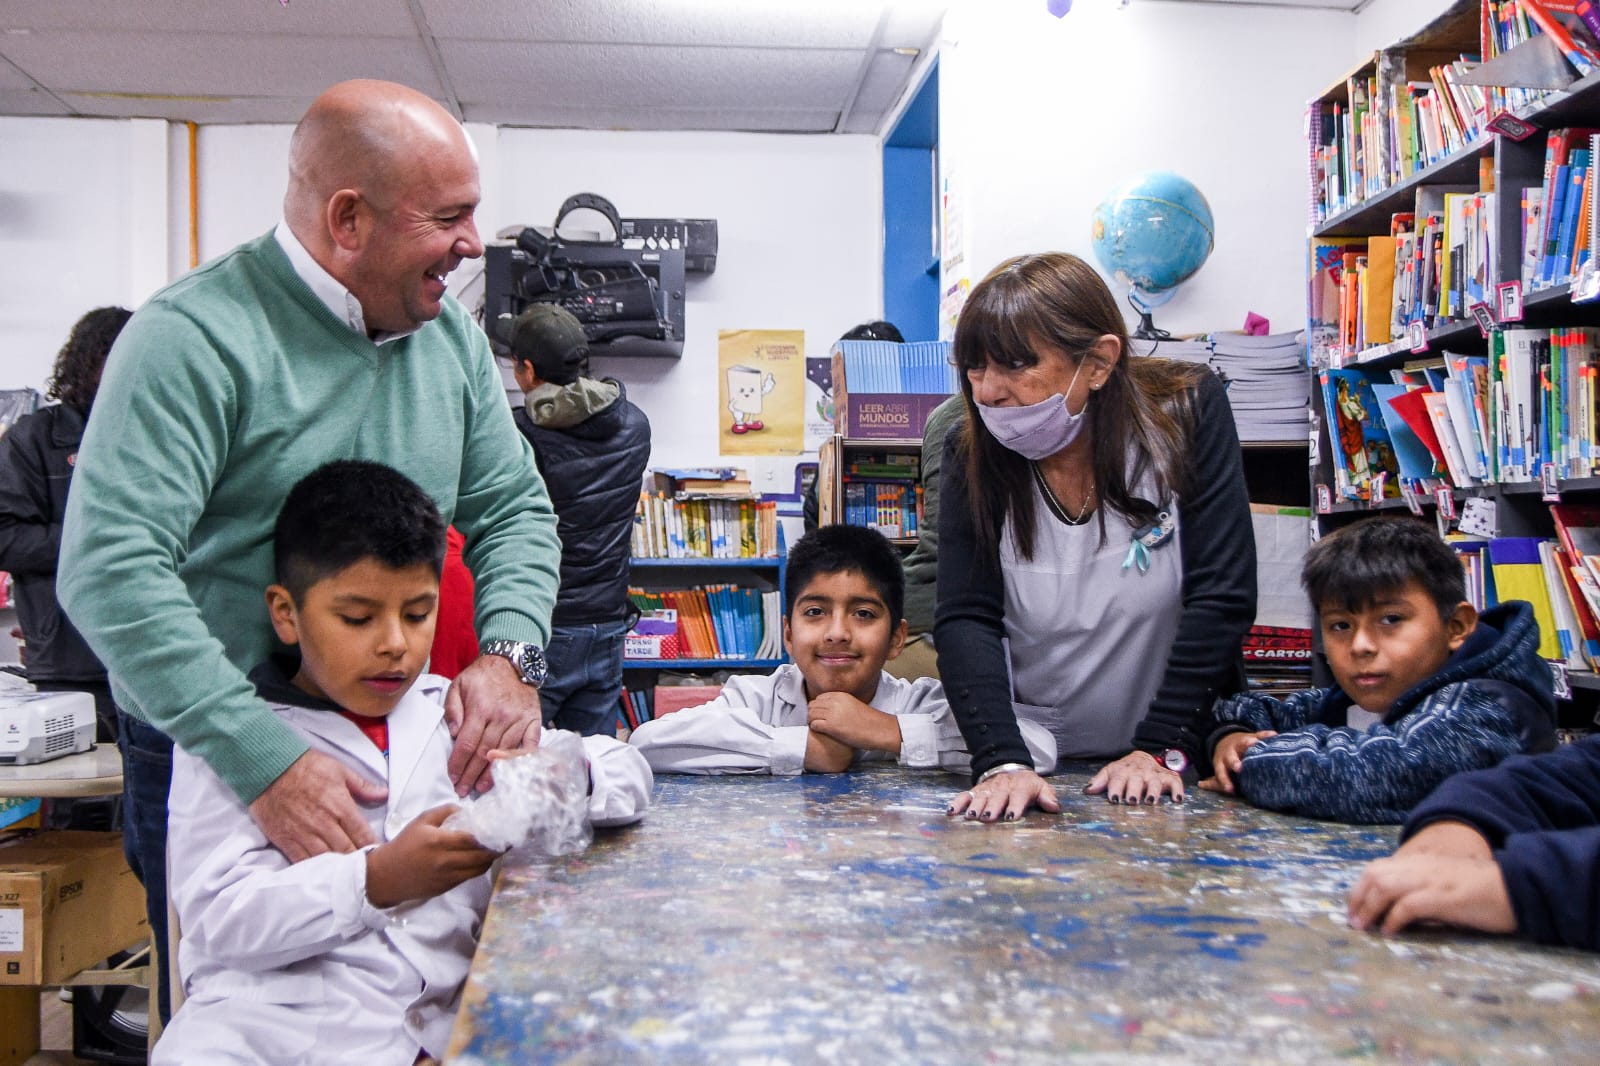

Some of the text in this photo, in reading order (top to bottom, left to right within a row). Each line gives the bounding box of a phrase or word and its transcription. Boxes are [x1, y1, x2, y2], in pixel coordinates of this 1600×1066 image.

[1502, 286, 1514, 319] F
[859, 403, 910, 413] LEER ABRE
[859, 413, 910, 424] MUNDOS
[626, 647, 653, 656] TARDE
[60, 880, 84, 898] EPSON
